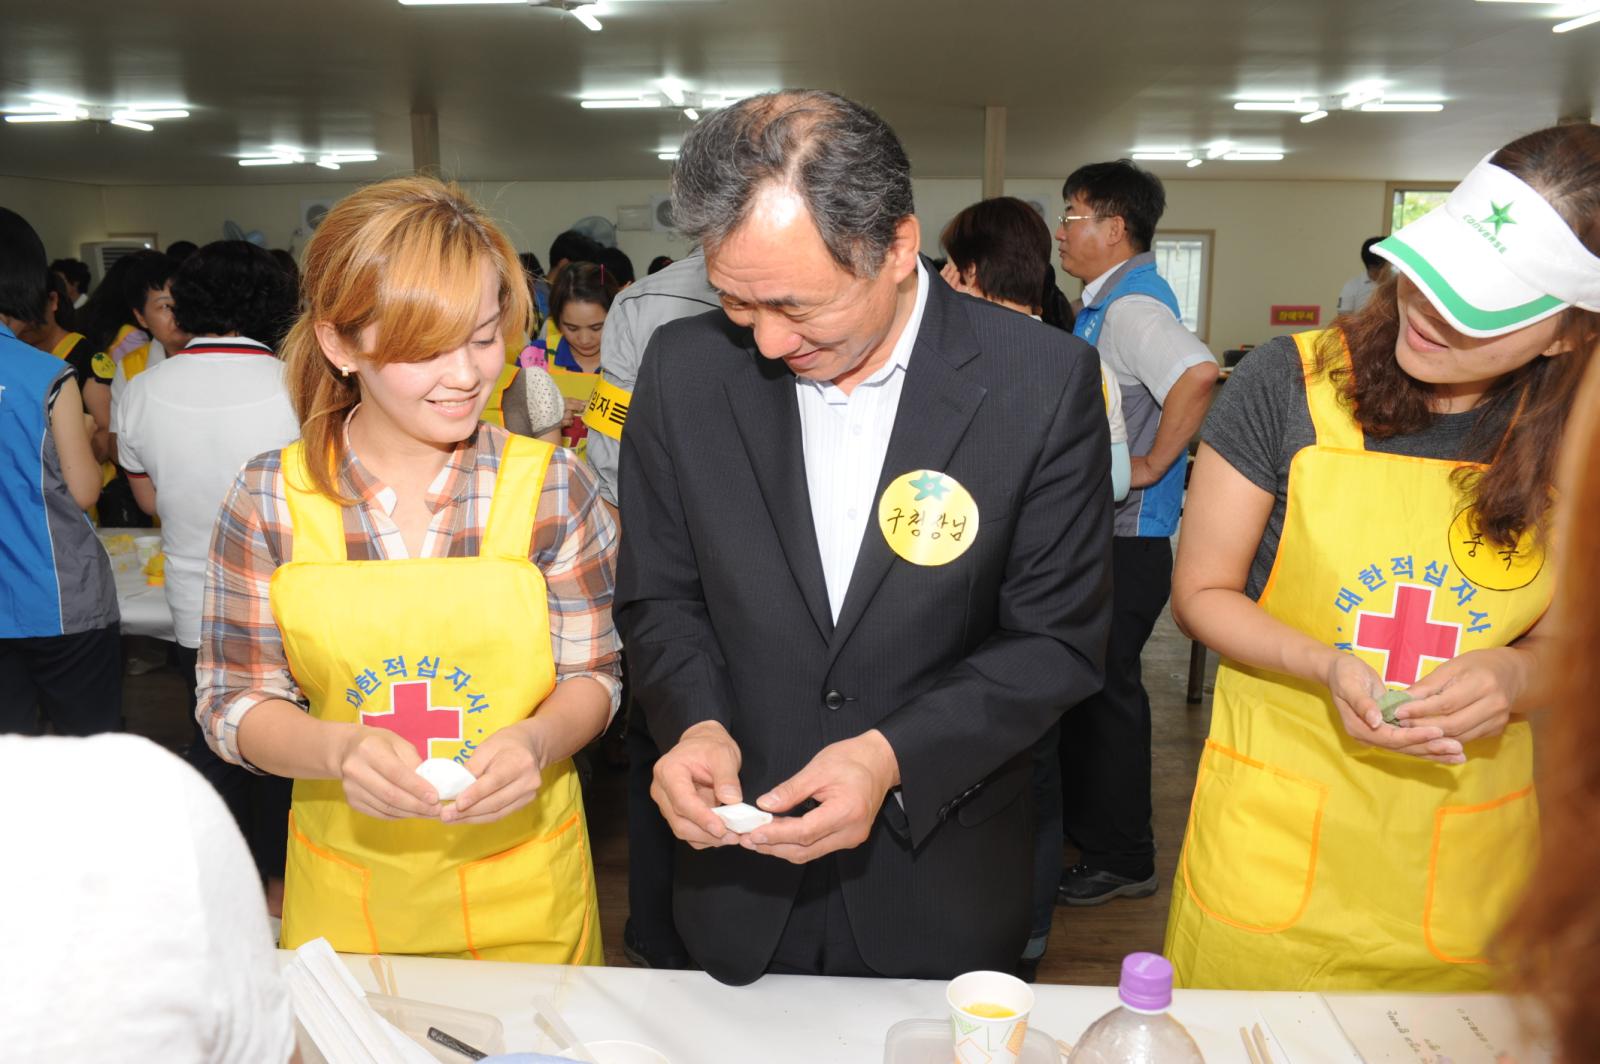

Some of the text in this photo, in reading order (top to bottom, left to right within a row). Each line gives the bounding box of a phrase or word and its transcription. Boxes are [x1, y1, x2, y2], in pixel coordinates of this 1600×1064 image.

[886, 507, 967, 542] 구청장님
[1334, 555, 1492, 634] 대한적십자사
[346, 655, 489, 714] 대한적십자사
